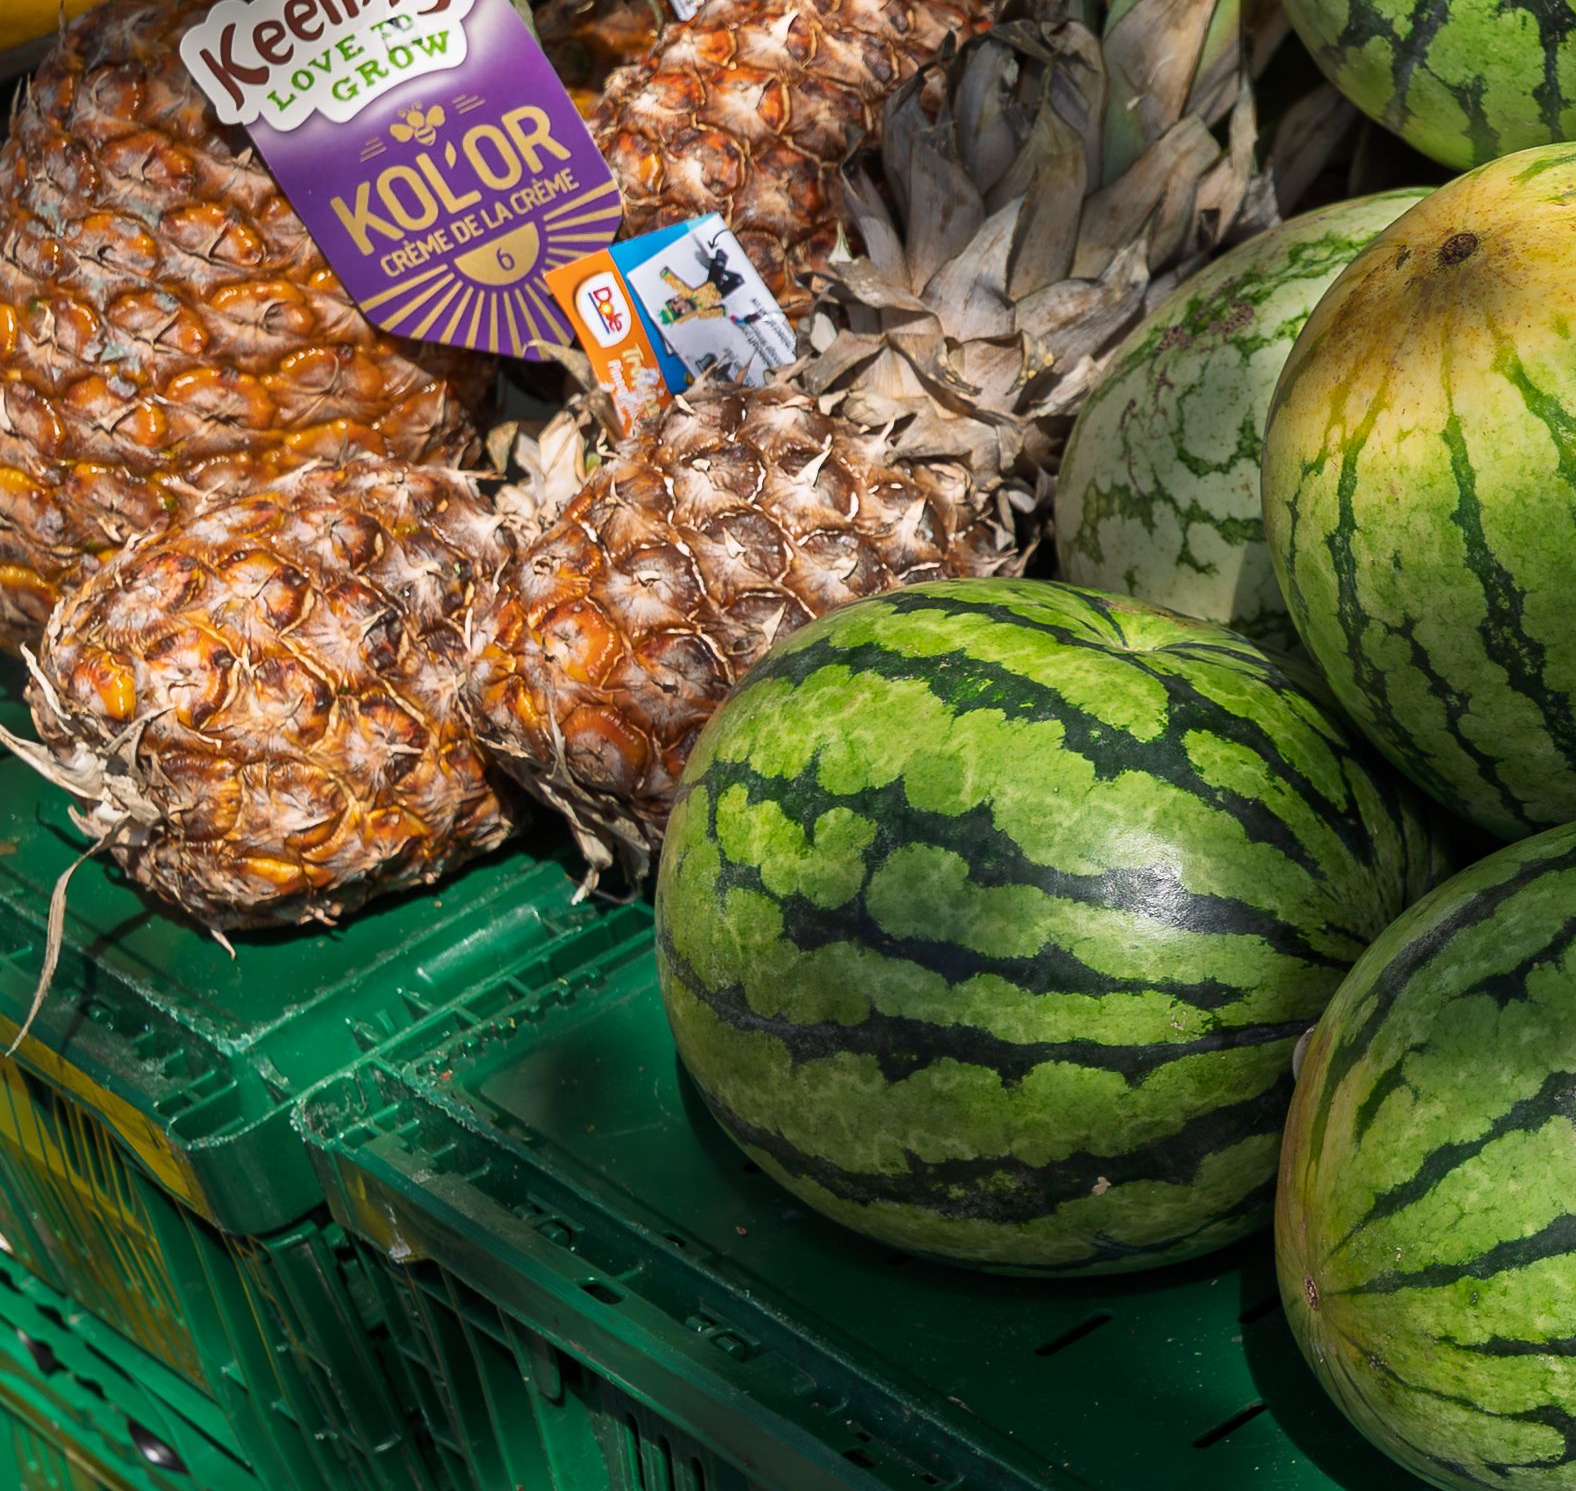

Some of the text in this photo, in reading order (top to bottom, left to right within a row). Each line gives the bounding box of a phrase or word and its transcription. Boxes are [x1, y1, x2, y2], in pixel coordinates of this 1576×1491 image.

[267, 33, 365, 112] LOVE
[331, 30, 450, 102] GROW
[380, 167, 580, 278] CRÈME DE LA CRÈME
[496, 248, 515, 271] 6
[593, 286, 623, 333] Dole
